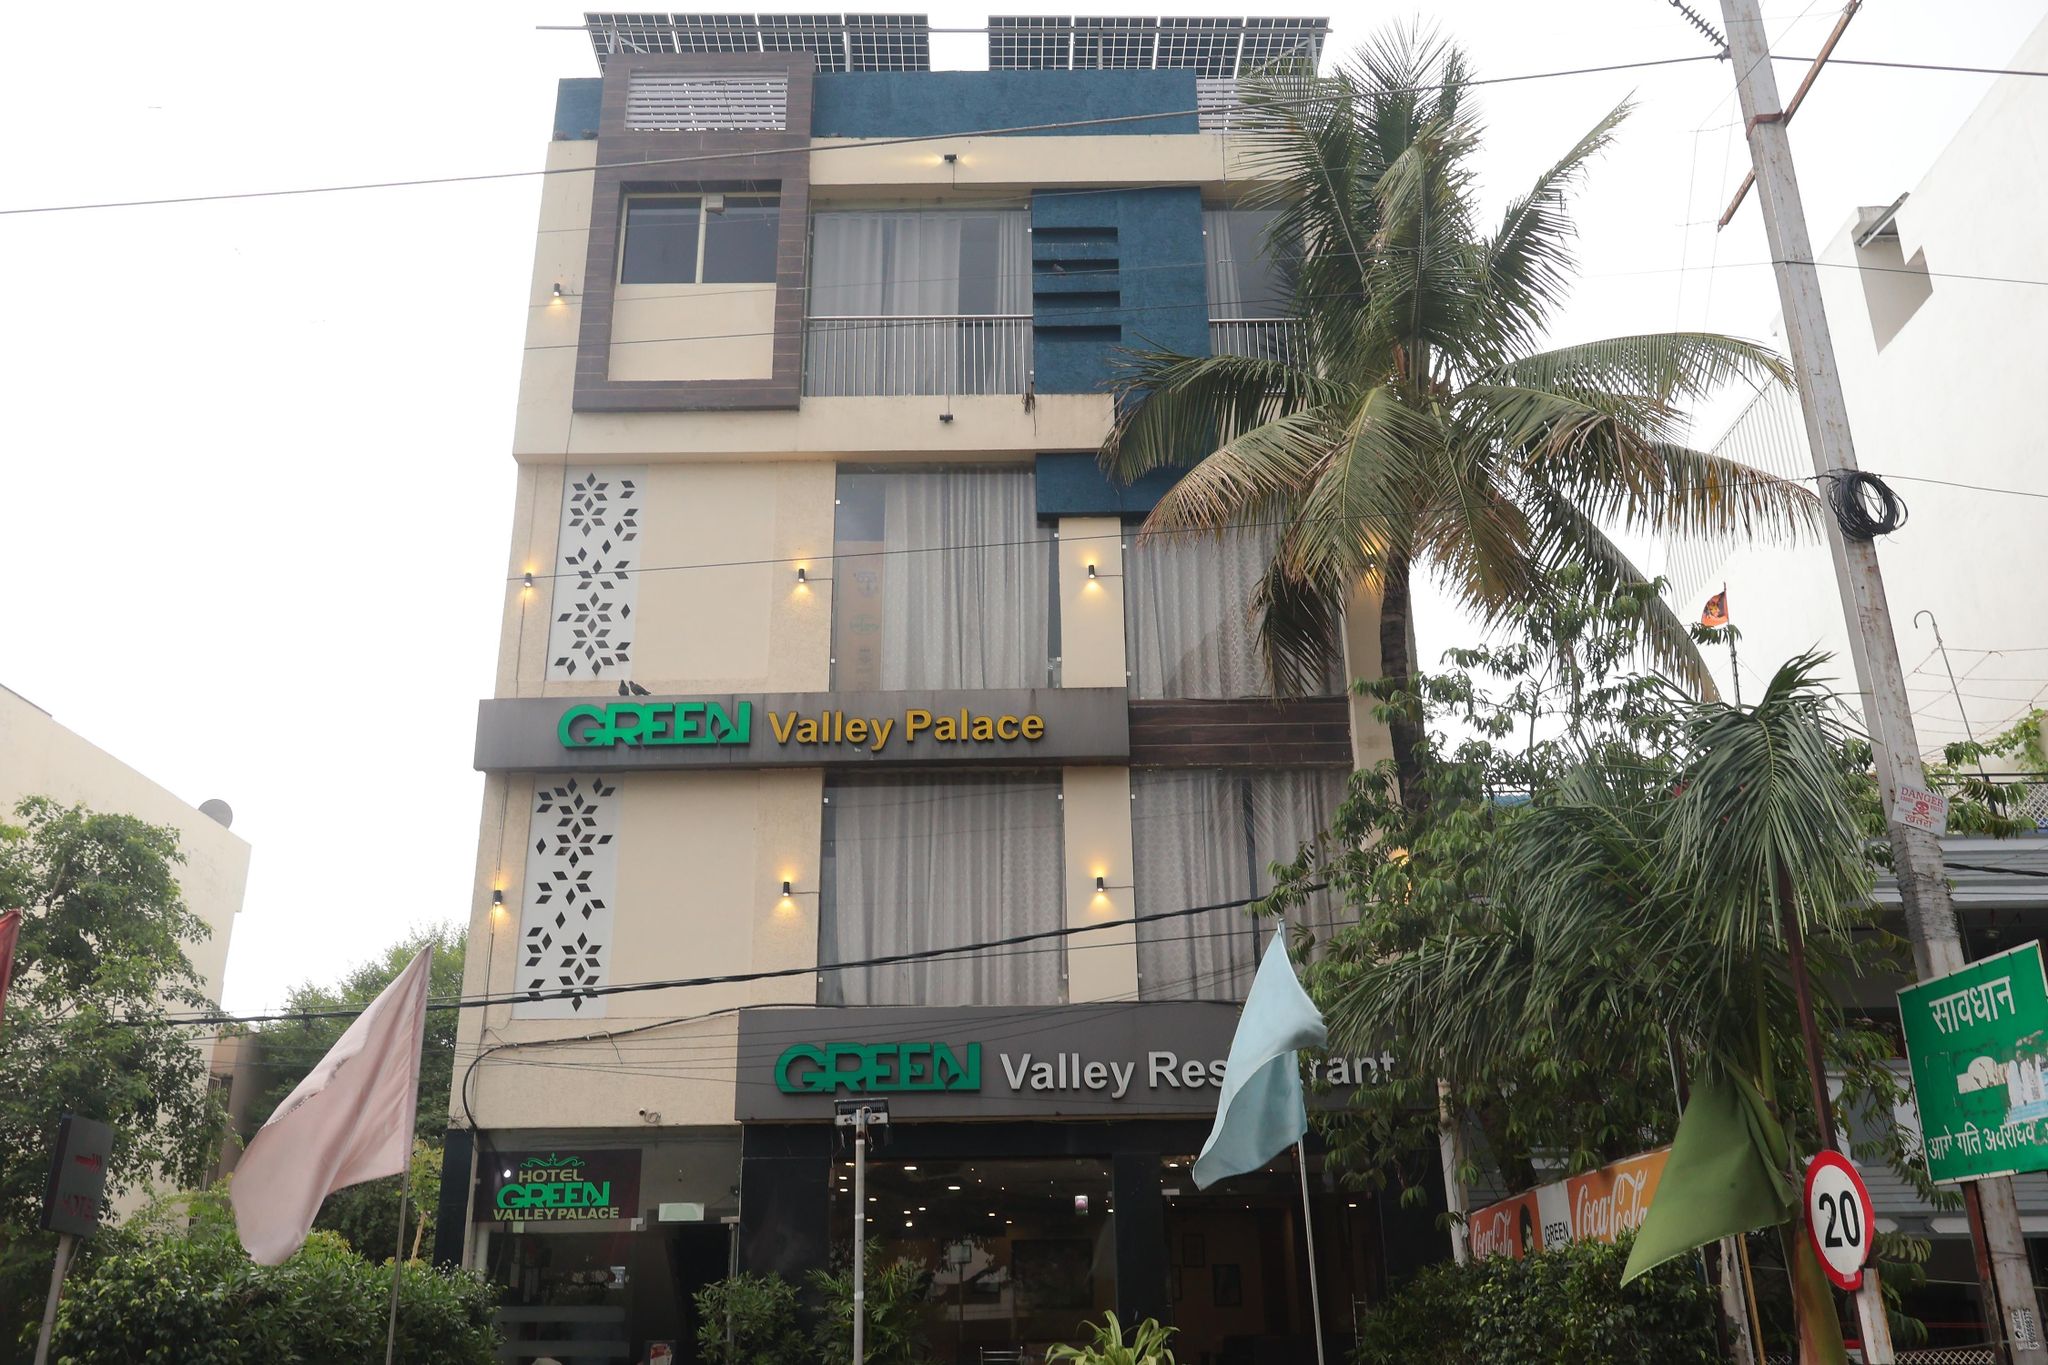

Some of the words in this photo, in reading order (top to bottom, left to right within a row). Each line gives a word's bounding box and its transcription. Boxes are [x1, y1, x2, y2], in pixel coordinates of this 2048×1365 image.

[557, 701, 752, 748] GREEN
[768, 709, 894, 751] Valley
[906, 708, 1044, 743] Palace
[1901, 787, 1944, 808] DANGER
[1905, 813, 1932, 829] खतरा
[1929, 976, 2016, 1034] सावधान
[774, 1042, 982, 1094] GREEN
[1000, 1052, 1136, 1100] Valley
[1955, 1121, 1982, 1156] गति
[518, 1168, 584, 1183] HOTEL
[496, 1181, 611, 1209] GREEN
[493, 1208, 556, 1221] VALLEY
[557, 1207, 620, 1220] PALACE
[1818, 1190, 1861, 1248] 20
[1544, 1220, 1569, 1243] GREEN
